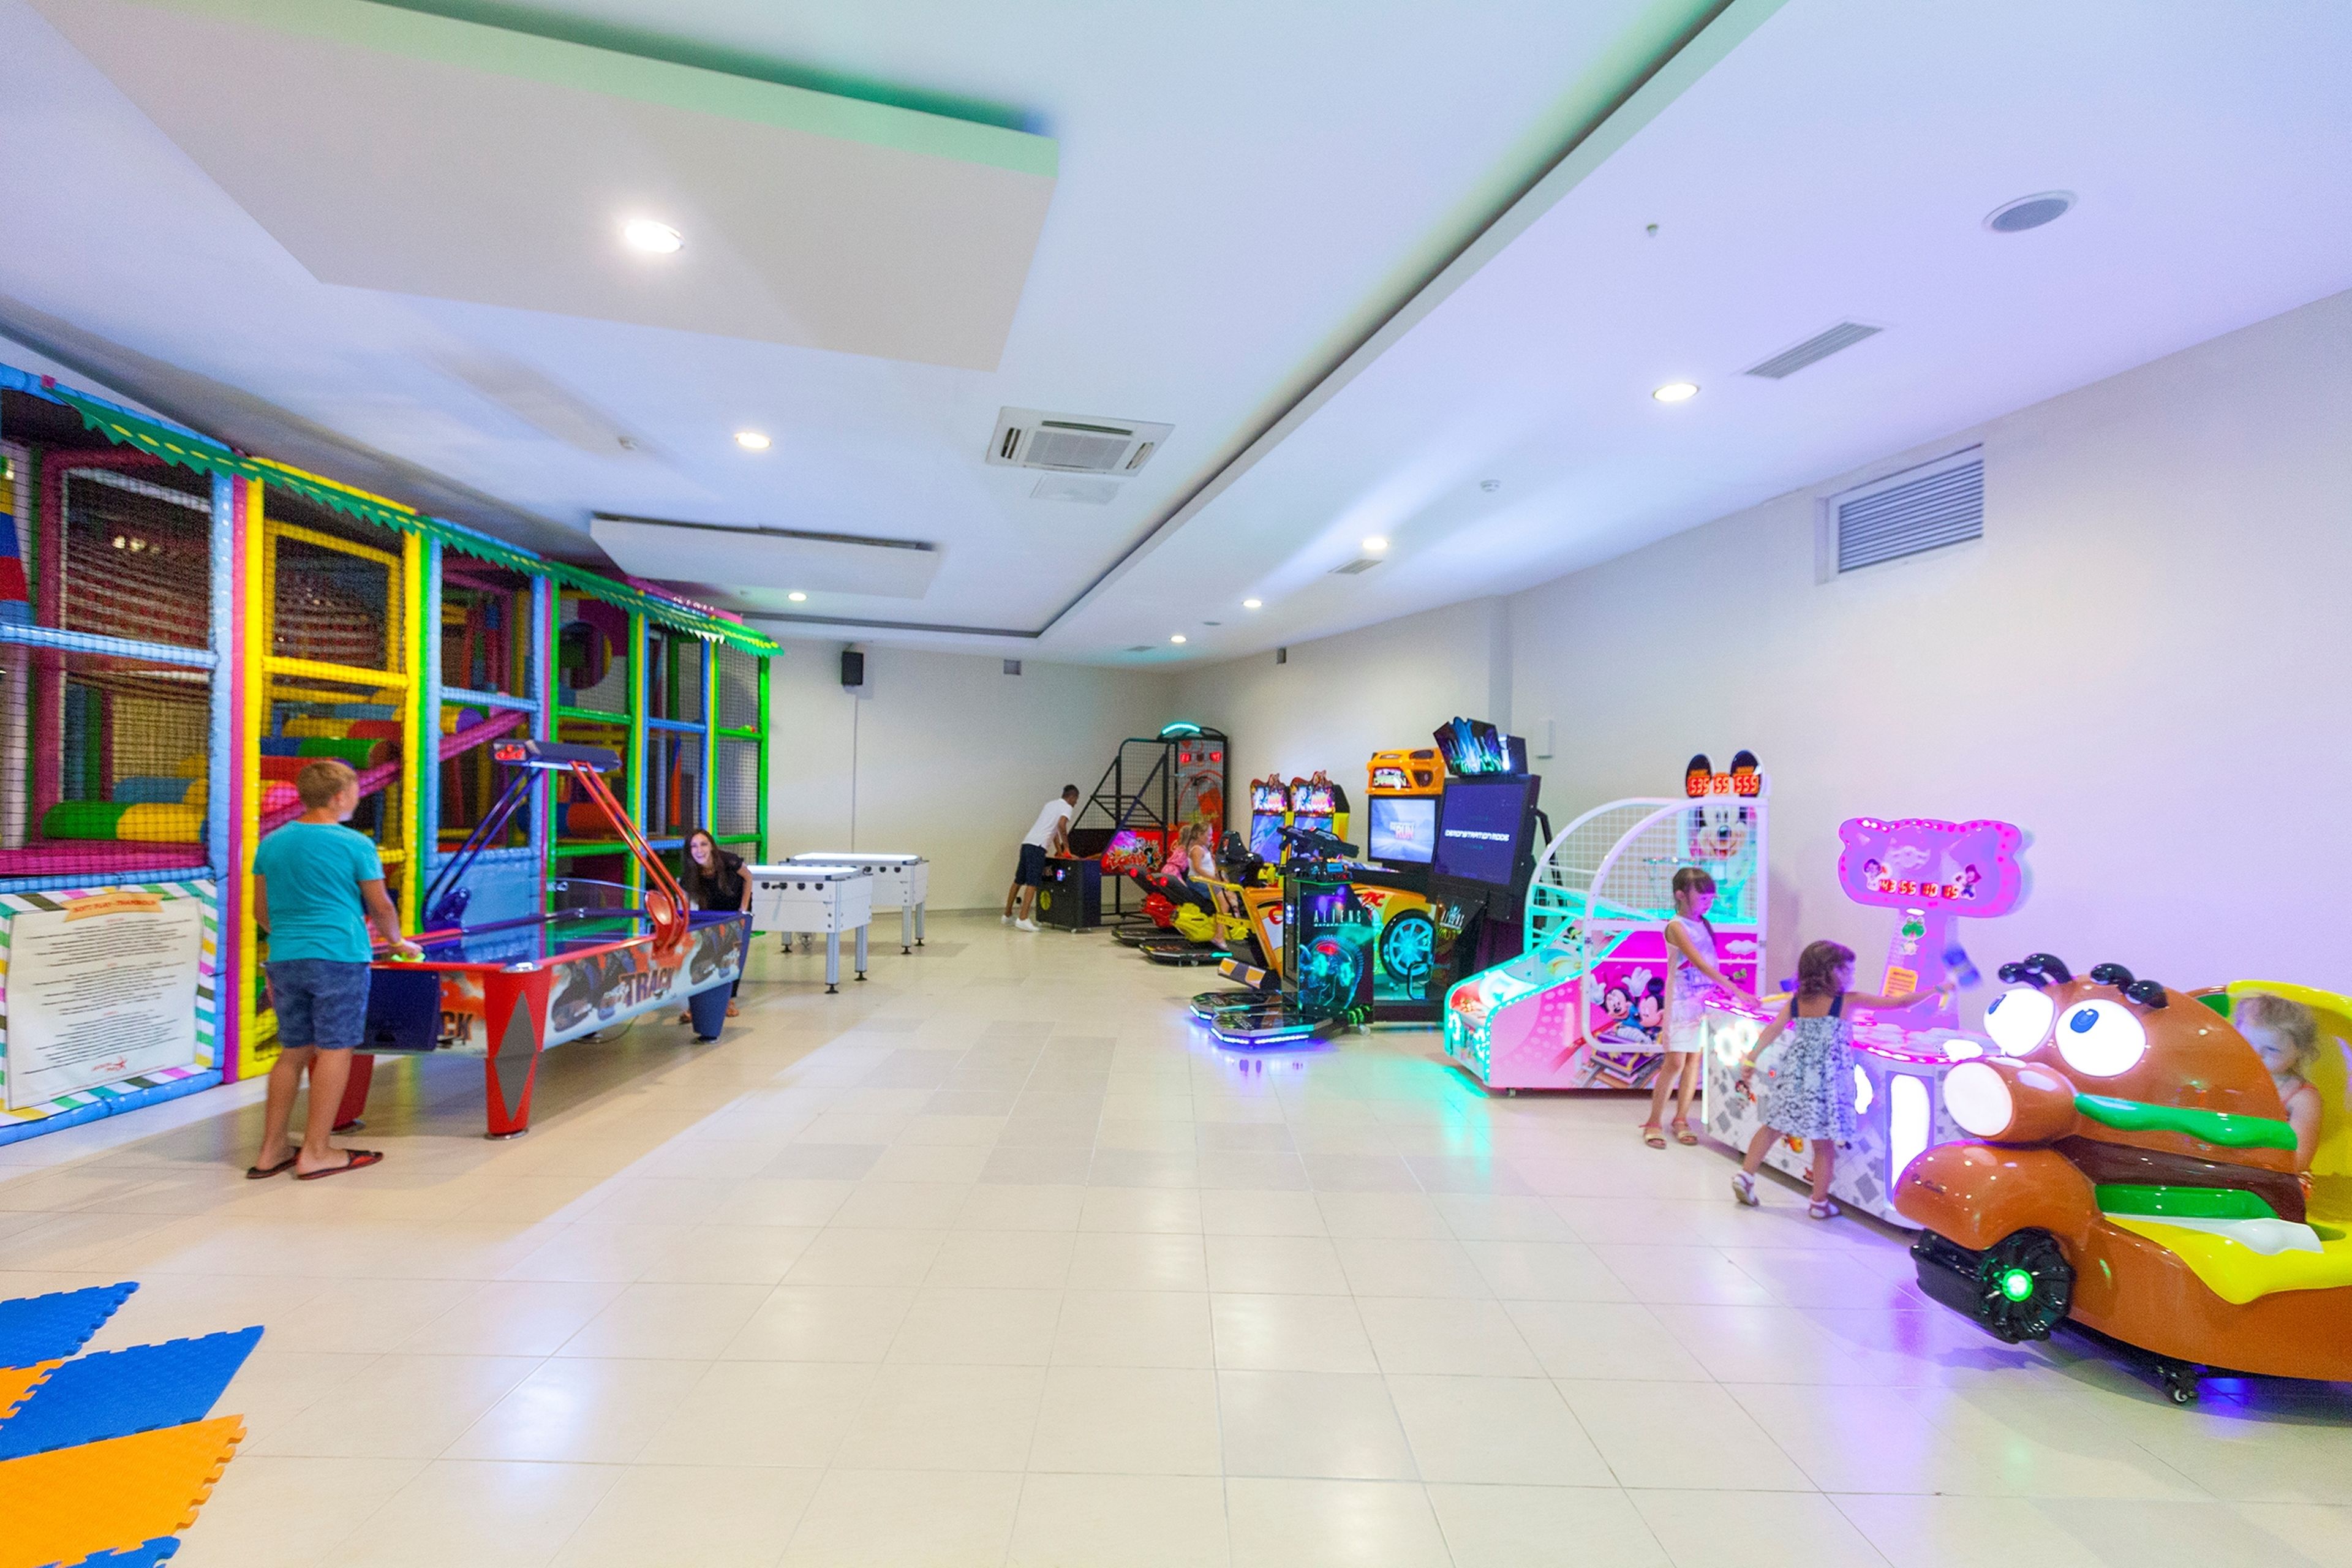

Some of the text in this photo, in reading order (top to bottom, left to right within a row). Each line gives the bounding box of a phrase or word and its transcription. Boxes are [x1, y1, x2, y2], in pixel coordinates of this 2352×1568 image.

[1714, 776, 1730, 793] 55
[1736, 776, 1758, 793] 555
[1444, 829, 1510, 842] DEMONSTRATION MODE
[1314, 909, 1361, 923] ALIENS
